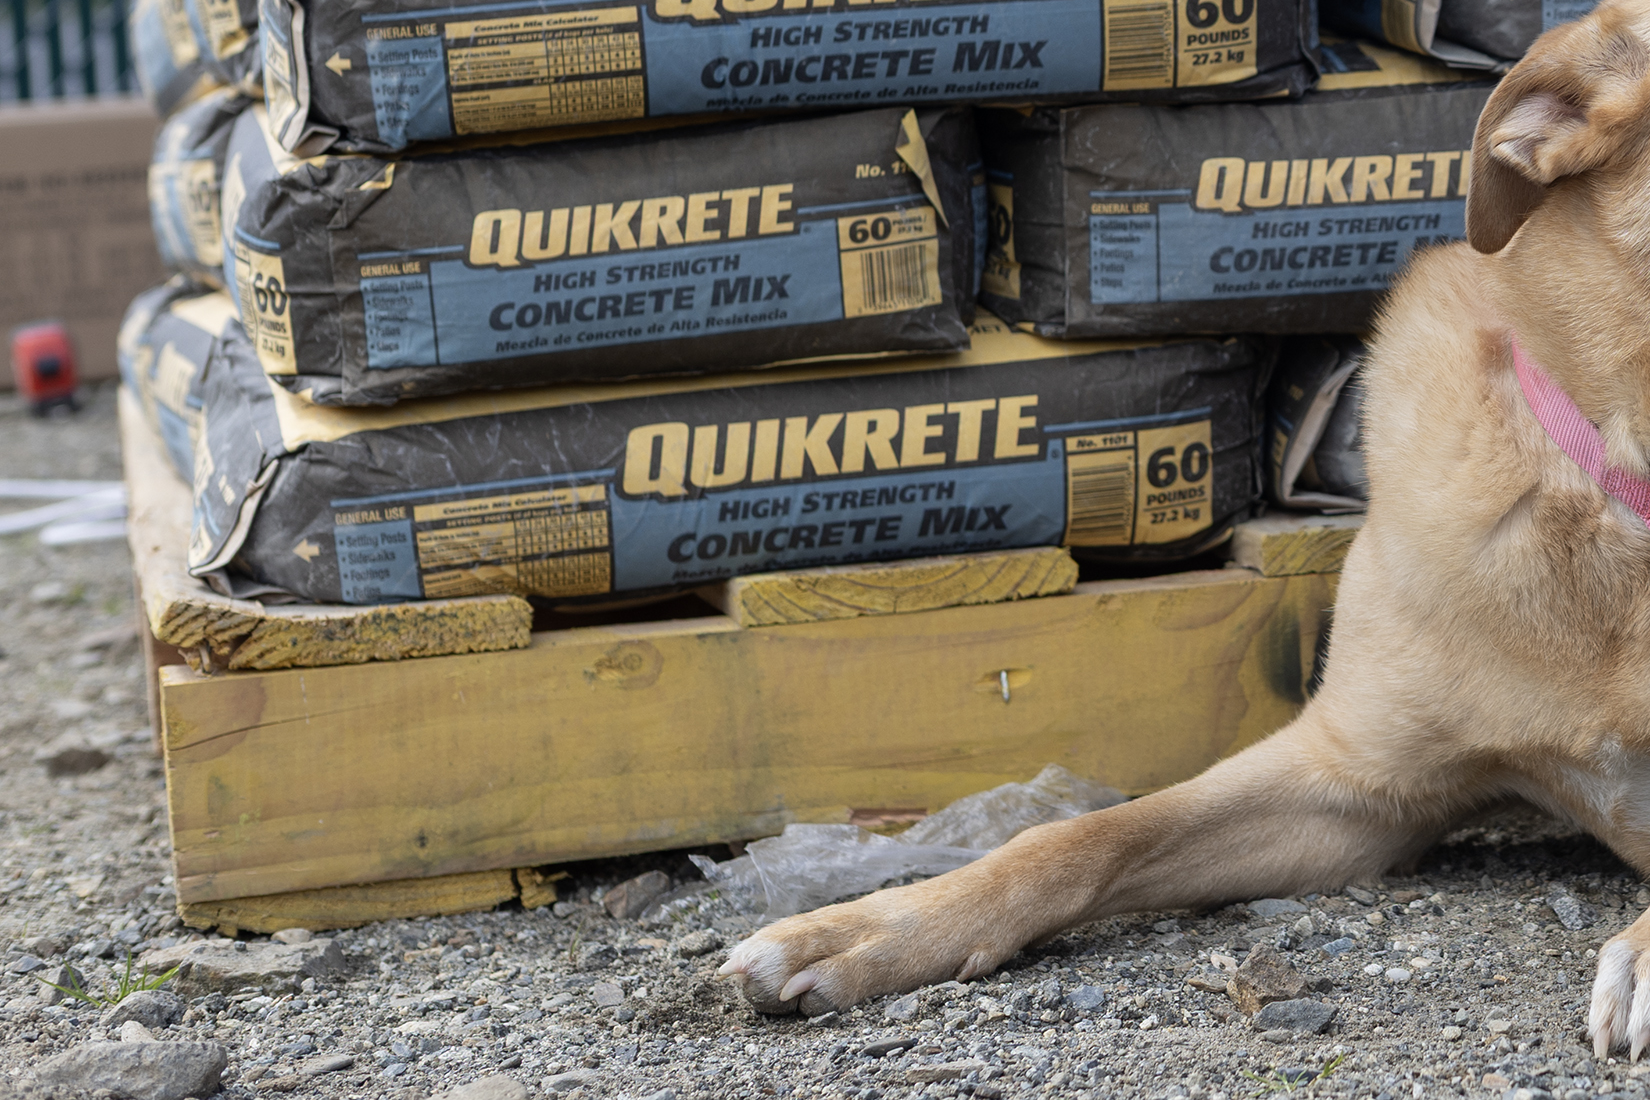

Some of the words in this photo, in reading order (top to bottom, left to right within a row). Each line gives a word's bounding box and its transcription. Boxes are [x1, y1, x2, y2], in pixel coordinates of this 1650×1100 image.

[366, 25, 413, 40] GENERAL
[415, 23, 438, 37] USE
[750, 25, 824, 48] HIGH
[833, 14, 990, 44] STRENGTH
[1186, 28, 1250, 46] POUNDS
[700, 48, 937, 90] CONCRETE
[953, 39, 1048, 73] MIX
[1191, 52, 1223, 66] 27.2
[1226, 50, 1245, 66] kg
[855, 163, 886, 179] No.
[469, 183, 794, 267] QUIKRETE
[849, 217, 892, 244] 60
[1252, 221, 1310, 239] HIGH
[1317, 213, 1441, 235] STRENGTH
[360, 264, 400, 277] GENERAL
[402, 262, 421, 274] USE
[1209, 241, 1398, 273] CONCRETE
[533, 271, 597, 294] HIGH
[605, 254, 741, 286] STRENGTH
[252, 272, 288, 317] 60
[489, 285, 695, 331] CONCRETE
[710, 274, 792, 308] MIX
[622, 394, 1039, 496] QUIKRETE
[1077, 437, 1097, 447] No.
[1102, 435, 1129, 445] 1101
[1146, 442, 1210, 488] 60
[718, 497, 790, 523] HIGH
[801, 480, 957, 514] STRENGTH
[1146, 485, 1206, 505] POUNDS
[335, 509, 382, 526] GENERAL
[384, 507, 406, 520] USE
[1150, 510, 1179, 524] 27.2
[1182, 507, 1200, 522] kg
[346, 535, 377, 549] Setting
[380, 532, 407, 545] Posts
[666, 516, 902, 564] CONCRETE
[917, 504, 1013, 538] MIX
